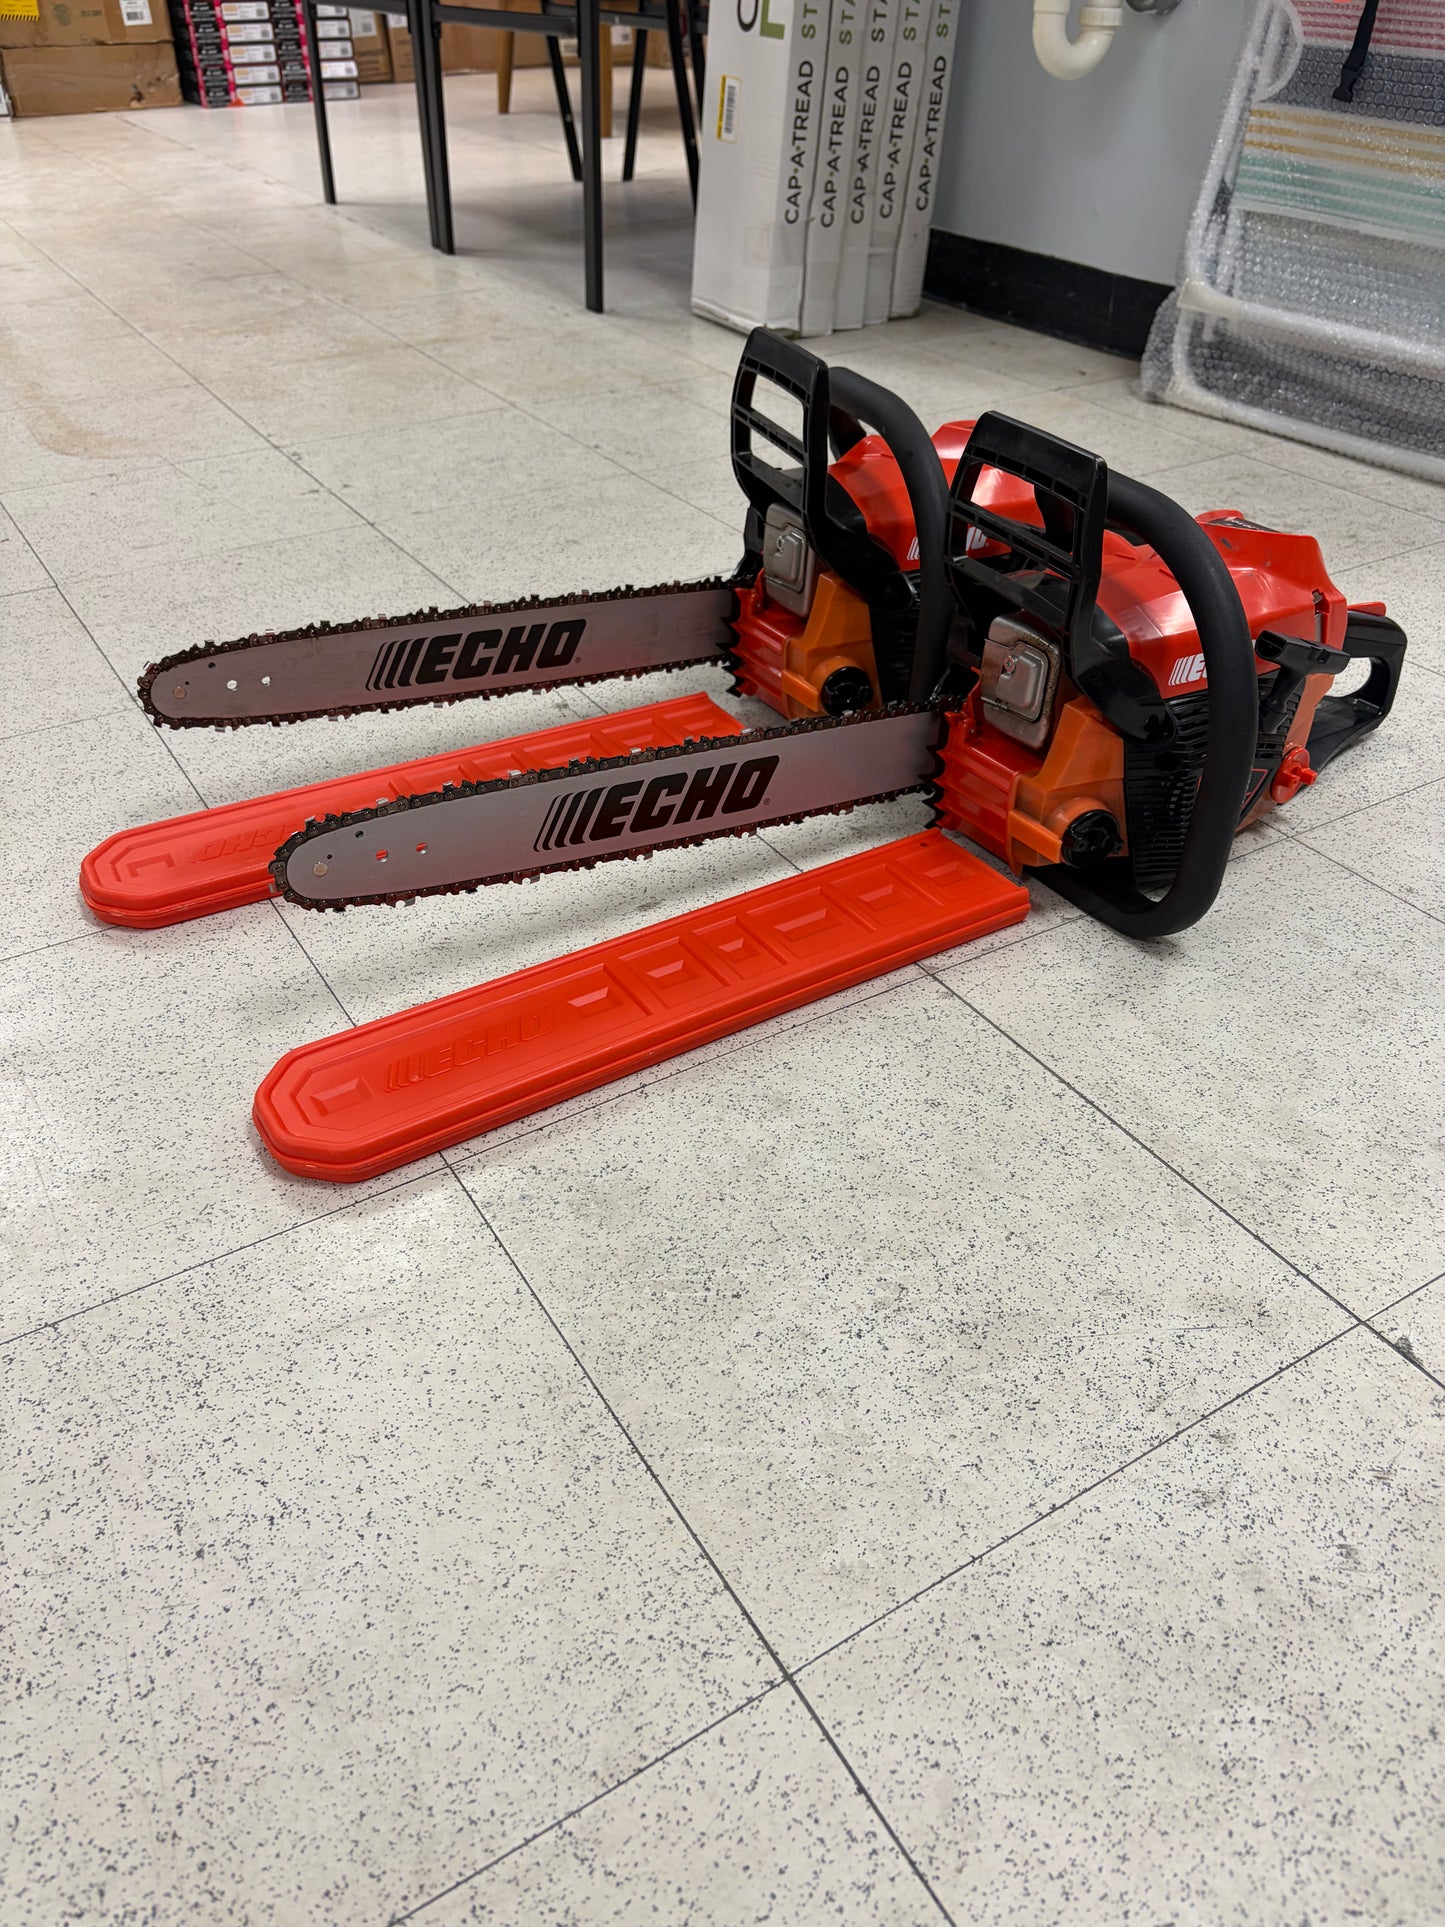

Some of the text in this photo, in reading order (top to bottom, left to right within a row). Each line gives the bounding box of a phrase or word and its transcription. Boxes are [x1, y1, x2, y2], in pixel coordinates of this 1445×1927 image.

[415, 618, 587, 684] ECHO
[589, 755, 780, 842] ECHO
[424, 1009, 554, 1077] ECHO
